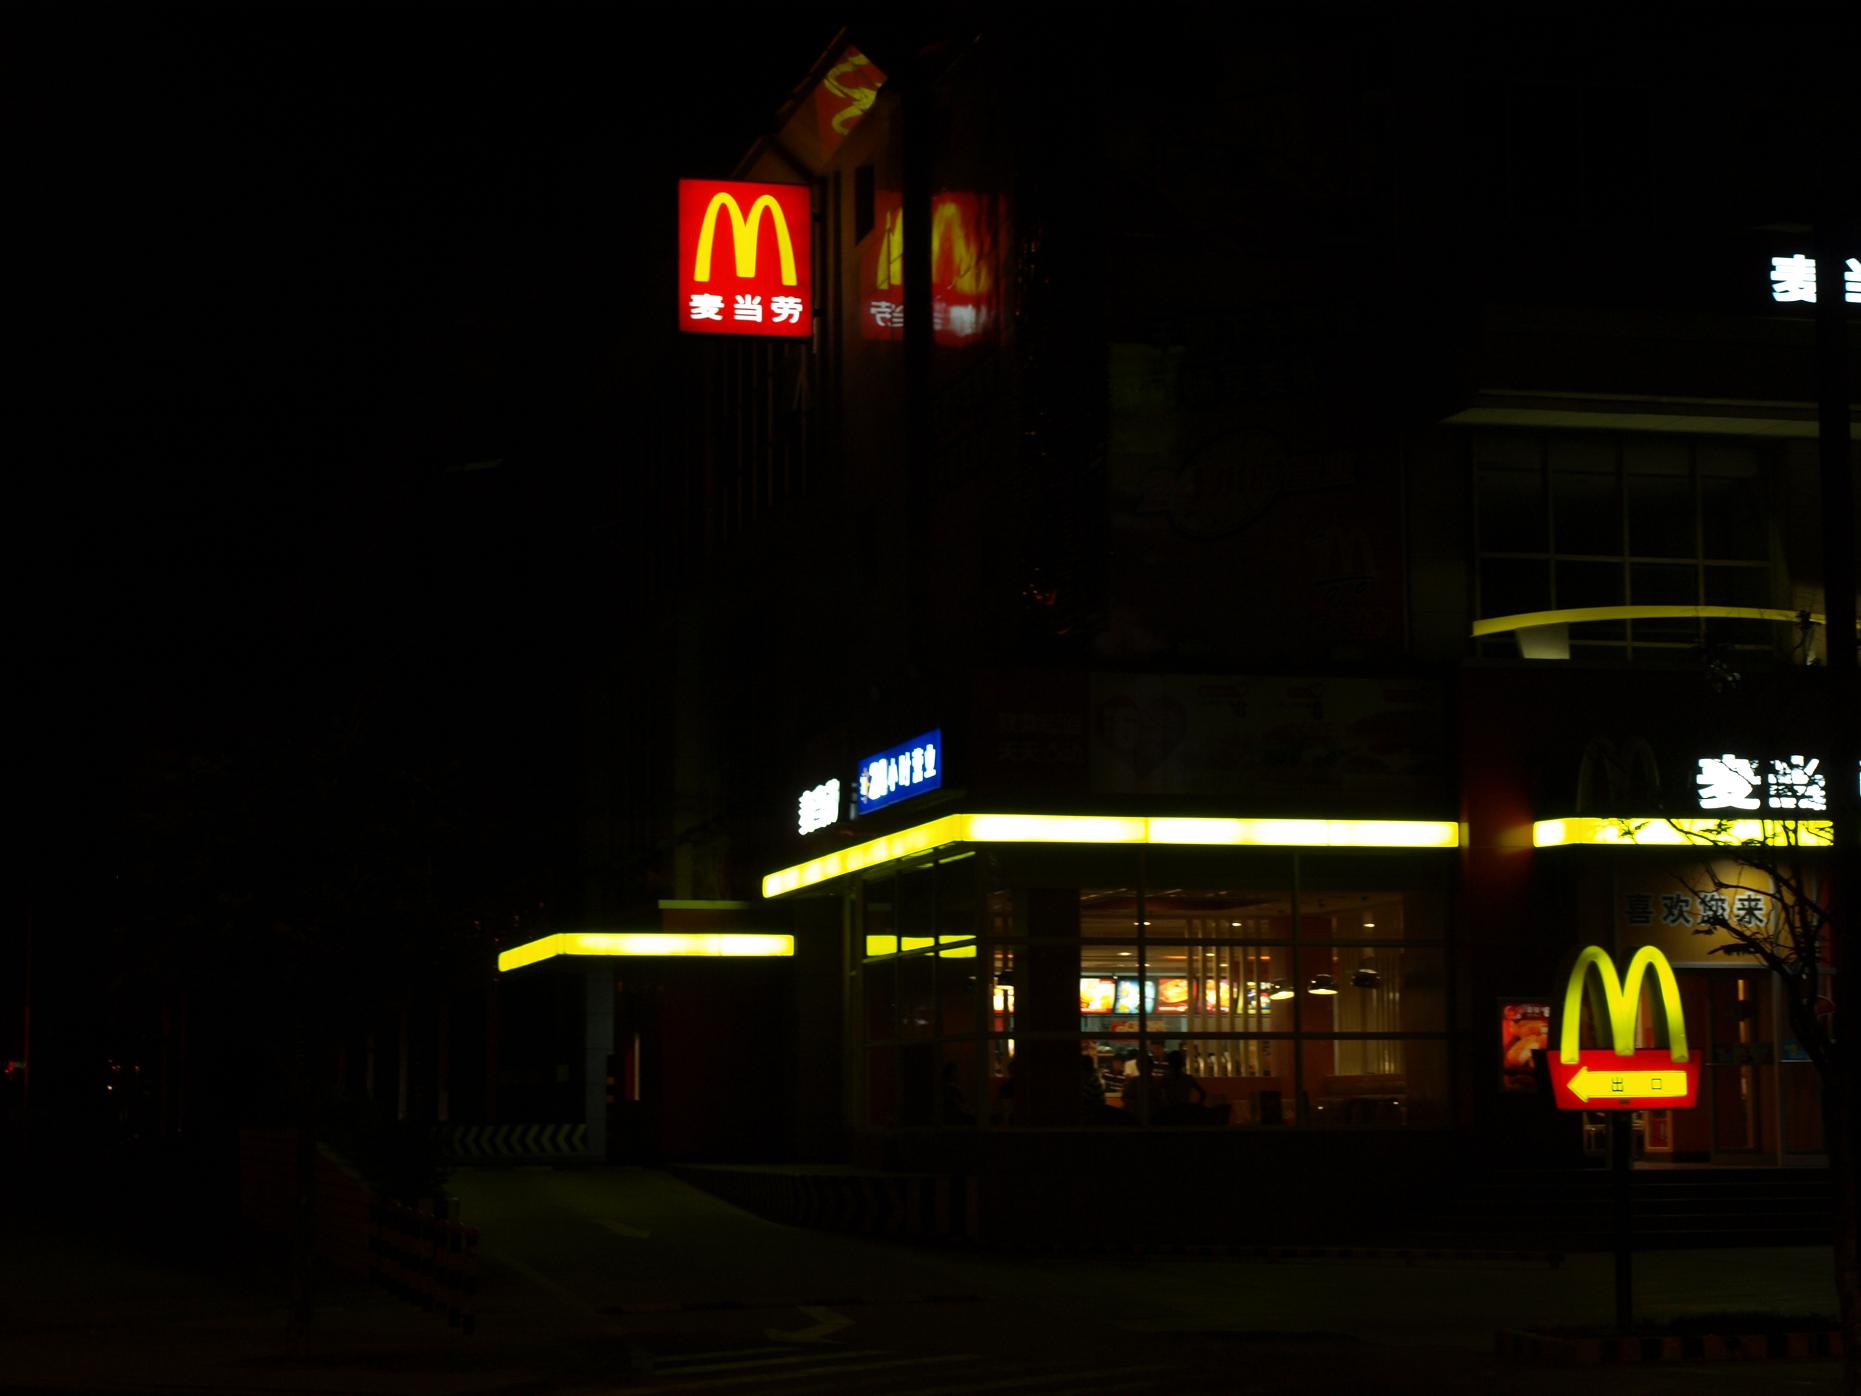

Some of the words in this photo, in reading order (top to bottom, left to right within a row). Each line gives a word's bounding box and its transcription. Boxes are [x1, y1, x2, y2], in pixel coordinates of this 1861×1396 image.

[689, 294, 803, 324] 麦当劳
[1696, 754, 1861, 810] 麦当
[1626, 894, 1765, 926] 喜欢您来
[1611, 1077, 1662, 1092] 出口
